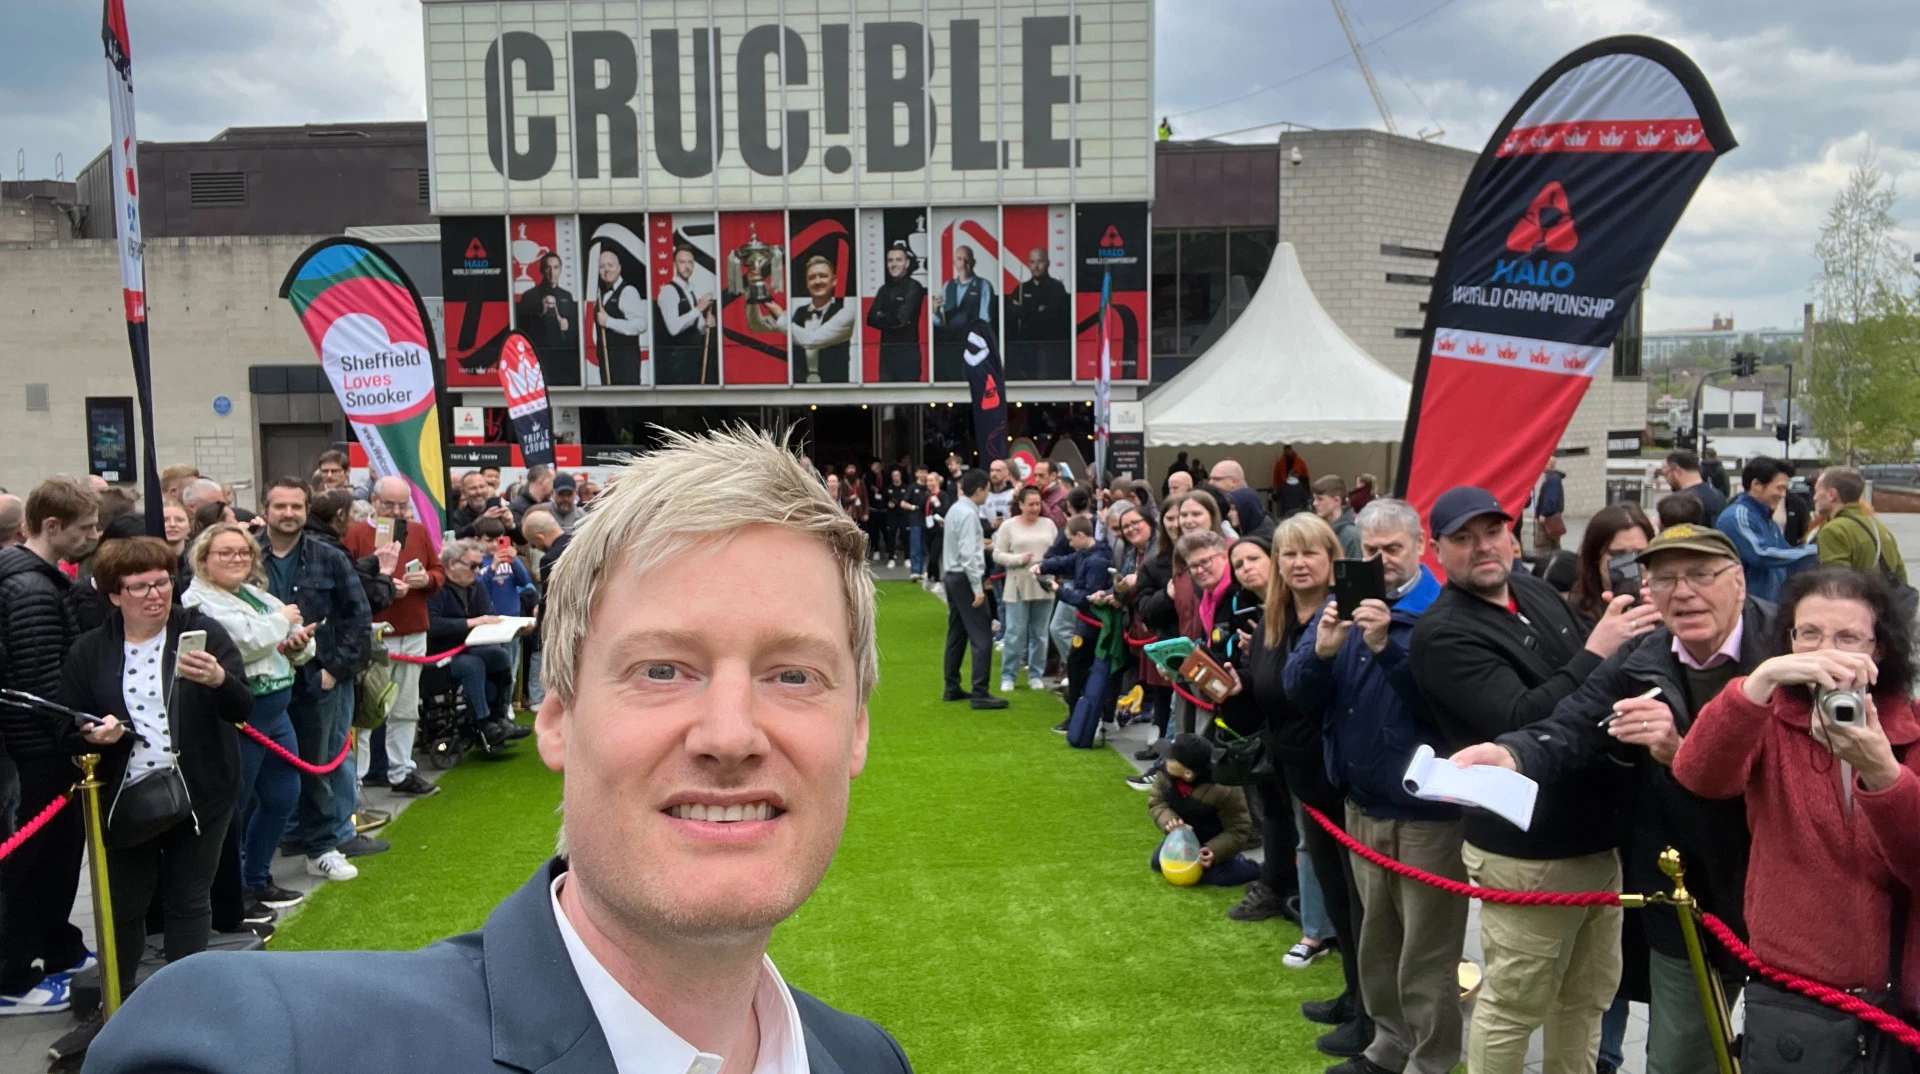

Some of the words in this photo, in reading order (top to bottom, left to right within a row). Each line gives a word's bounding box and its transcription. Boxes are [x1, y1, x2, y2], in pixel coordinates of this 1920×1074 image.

[464, 259, 489, 268] HALO
[1490, 258, 1575, 289] HALO
[1452, 285, 1501, 307] WORLD
[1503, 288, 1616, 319] CHAMPIONSHIP
[340, 349, 421, 372] Sheffield
[343, 374, 392, 390] Loves
[345, 387, 413, 408] Snooker
[523, 429, 550, 445] TRIPLE
[525, 440, 550, 455] CROWN
